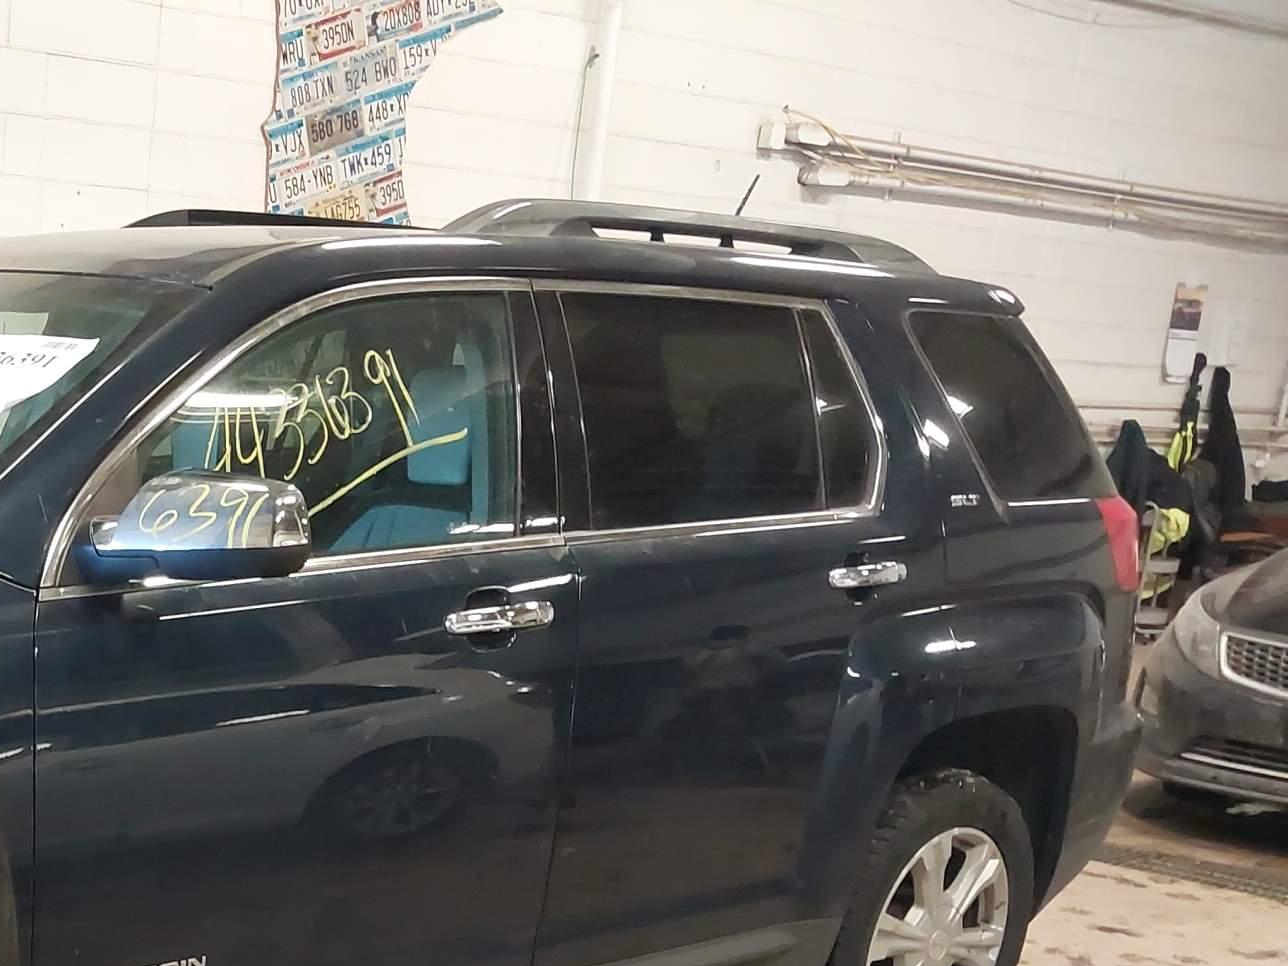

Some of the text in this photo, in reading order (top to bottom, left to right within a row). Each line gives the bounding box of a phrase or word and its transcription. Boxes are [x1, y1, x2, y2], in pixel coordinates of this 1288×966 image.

[403, 44, 423, 70] 159
[290, 82, 312, 108] 808
[312, 73, 334, 99] TXN
[344, 66, 368, 93] 524
[336, 110, 359, 133] 768
[368, 99, 389, 123] 448
[280, 129, 305, 155] VJX
[340, 154, 365, 179] TWK
[370, 143, 392, 168] 459
